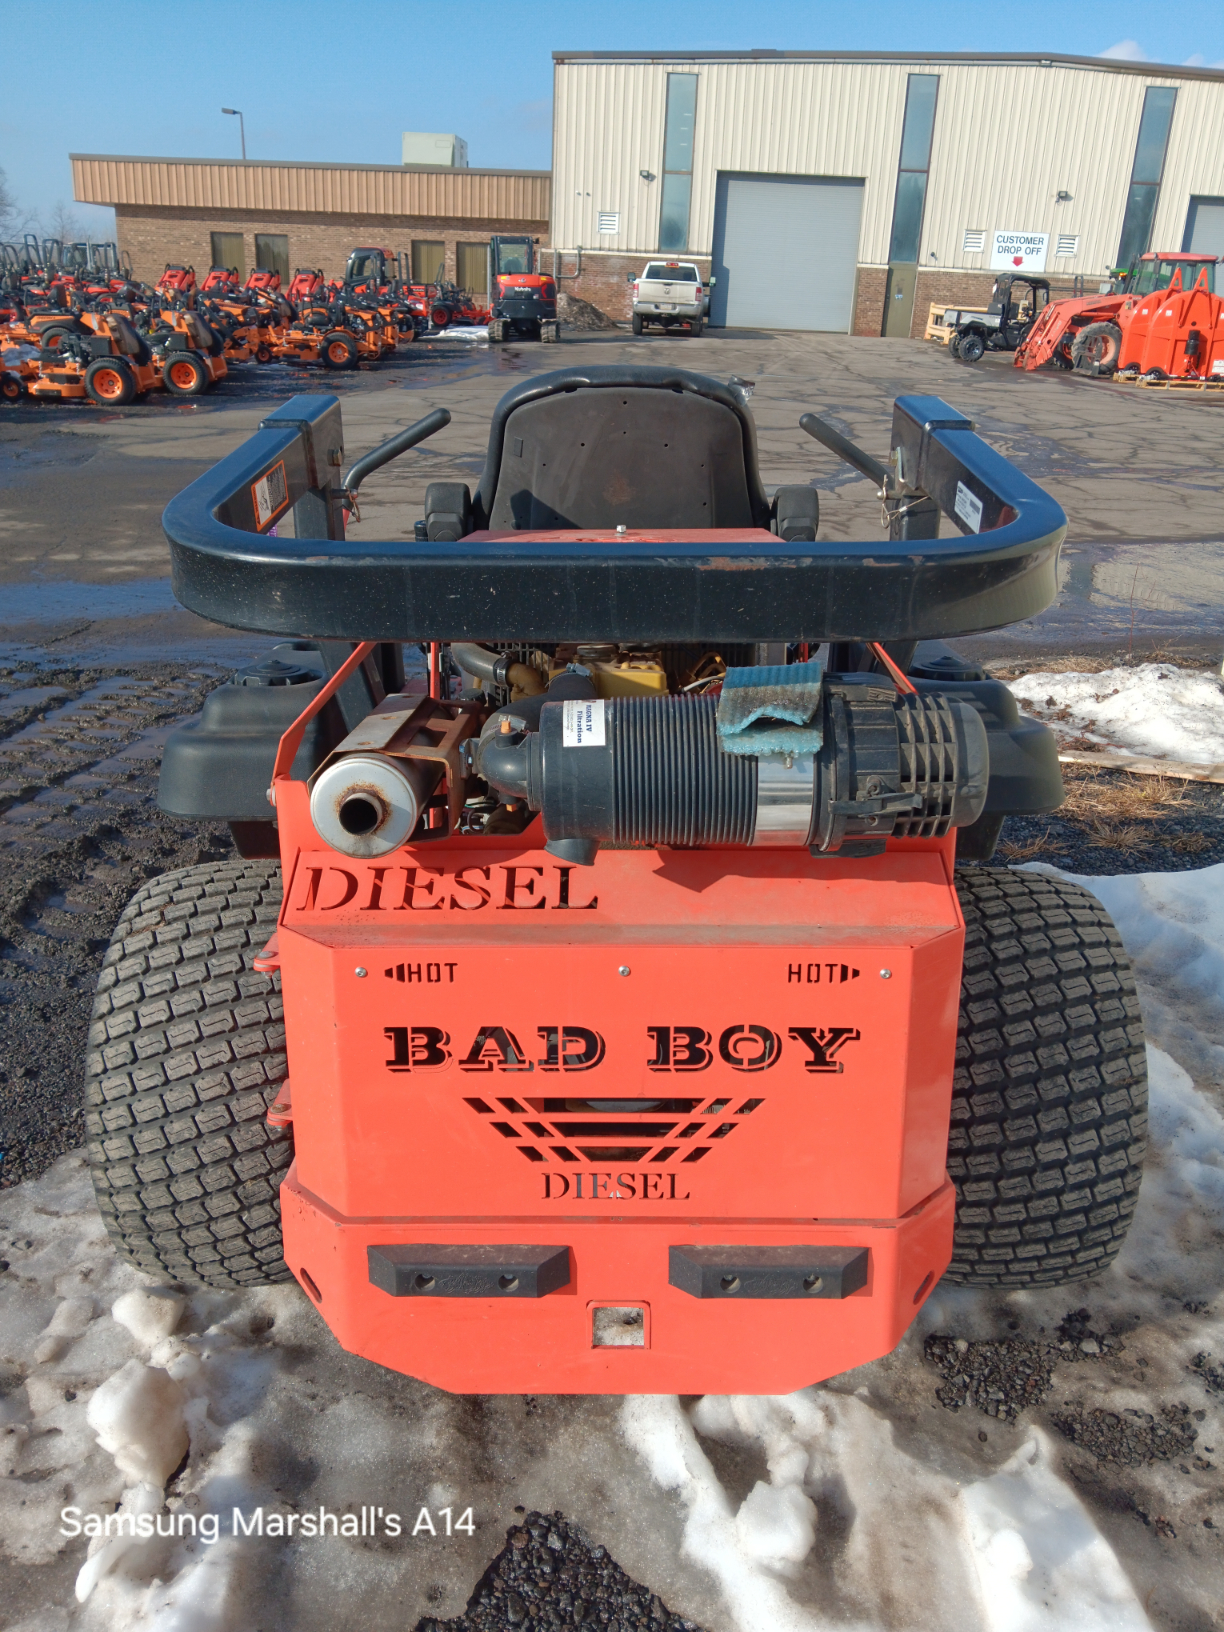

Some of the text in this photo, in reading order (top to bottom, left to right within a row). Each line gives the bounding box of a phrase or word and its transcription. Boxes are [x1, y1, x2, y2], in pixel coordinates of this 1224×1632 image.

[996, 235, 1044, 245] CUSTOMER
[997, 245, 1042, 255] DROP OFF
[296, 865, 599, 911] DIESEL
[407, 962, 458, 983] HOT
[787, 963, 839, 983] HOT
[383, 1024, 861, 1073] BAD BOY
[540, 1172, 691, 1200] DIESEL
